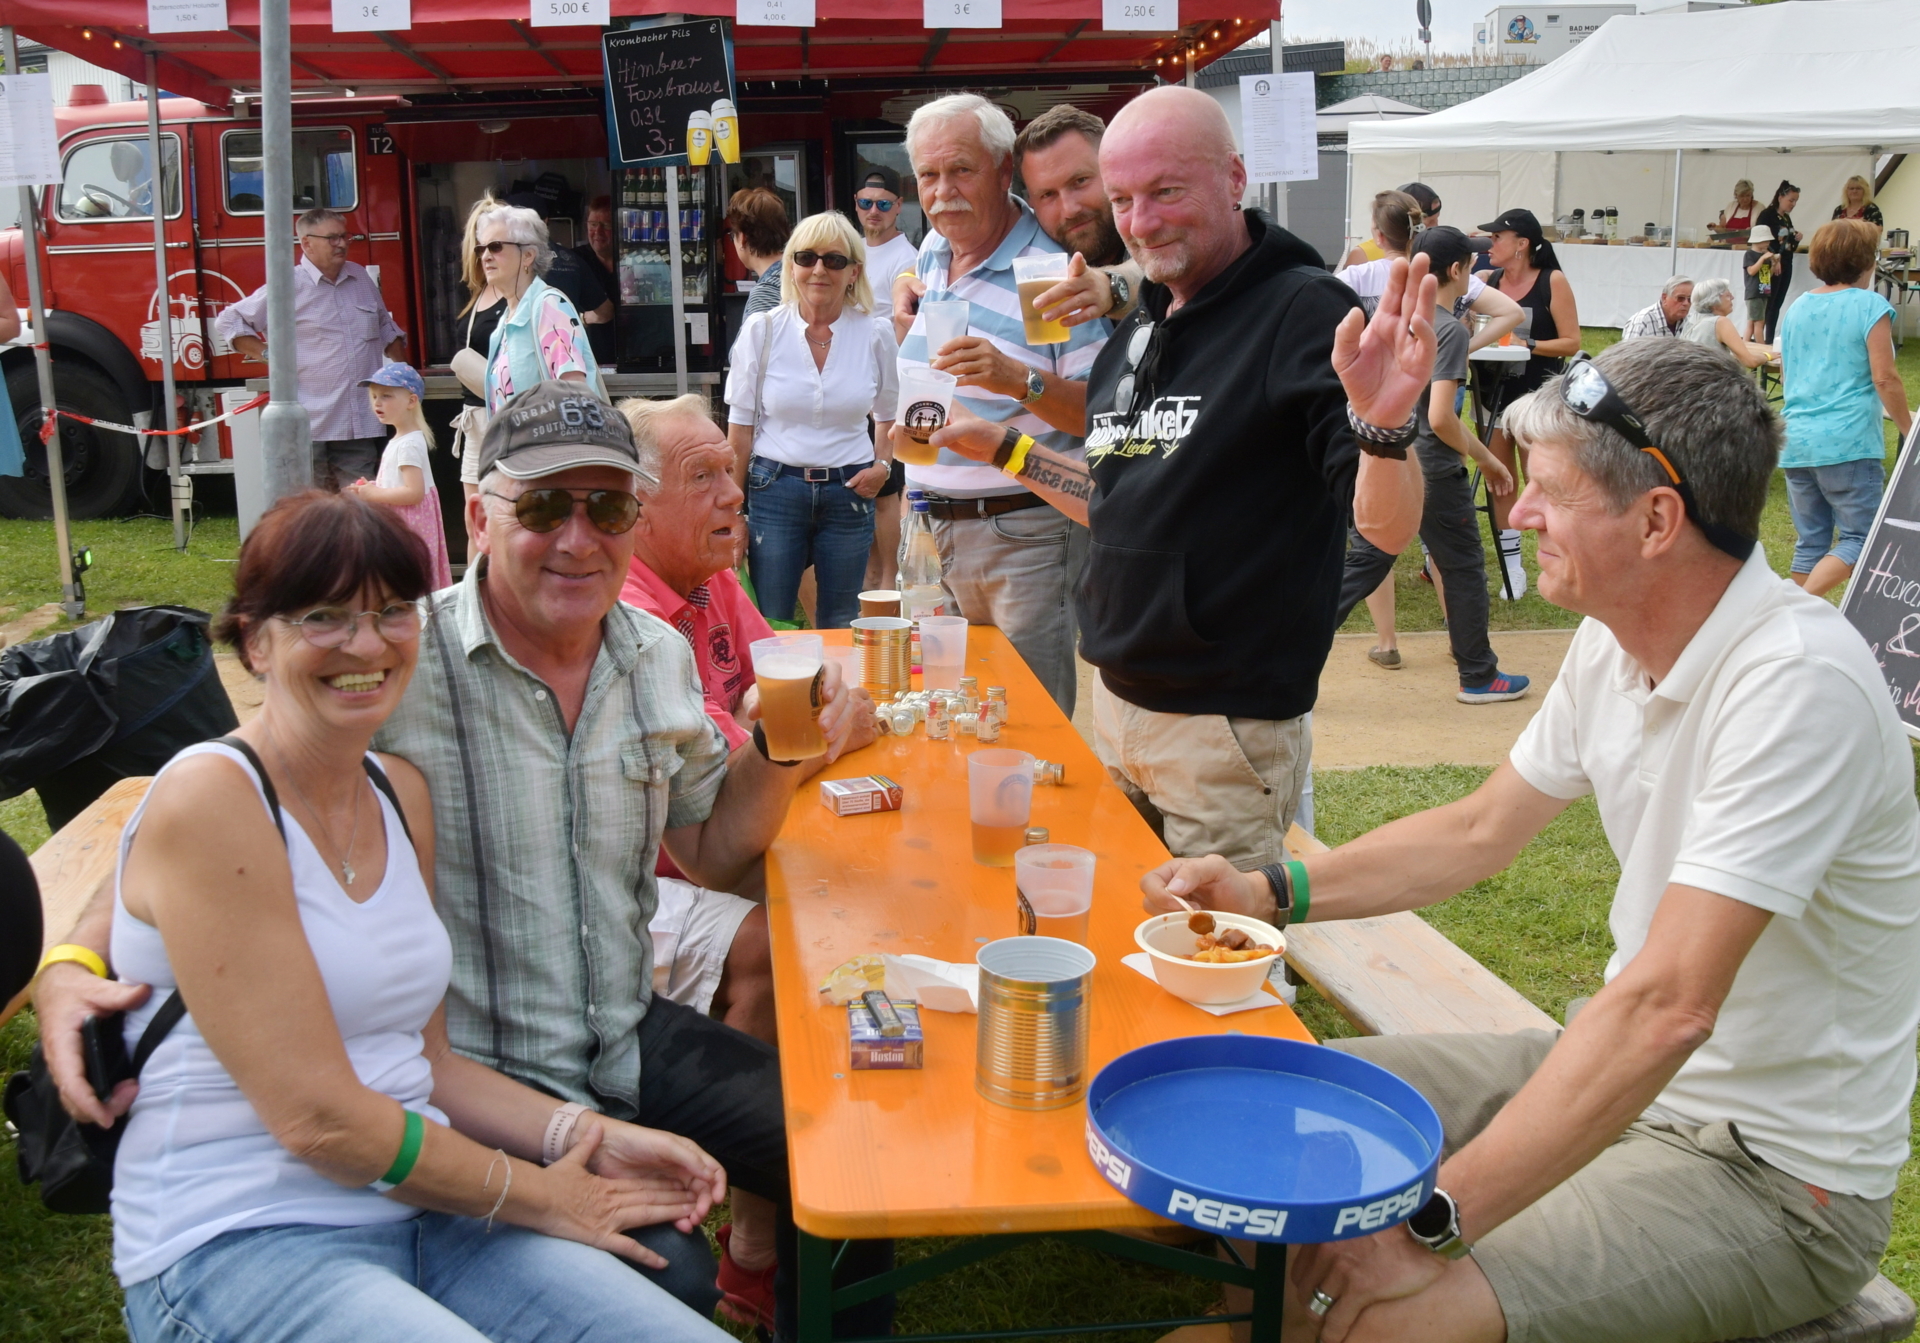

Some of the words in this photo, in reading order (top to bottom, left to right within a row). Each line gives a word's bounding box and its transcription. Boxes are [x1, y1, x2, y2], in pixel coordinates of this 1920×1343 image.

[176, 14, 192, 22] 1,50
[362, 6, 369, 18] 3
[371, 6, 379, 18] €
[550, 2, 579, 16] 5,00
[581, 2, 590, 14] €
[763, 13, 780, 21] 4,00
[954, 3, 961, 16] 3
[963, 3, 971, 15] €
[1124, 5, 1147, 18] 2,50
[1148, 6, 1156, 17] €
[609, 32, 668, 48] Krombacher
[671, 28, 691, 39] Pils
[709, 23, 717, 34] €
[617, 51, 702, 84] Himbeer
[623, 77, 724, 103] Fassbrause
[370, 136, 393, 154] T2
[0, 173, 37, 182] ECHERPFAND
[1254, 170, 1295, 178] BECHERPFAND
[511, 399, 556, 427] URBAN
[558, 399, 606, 428] 63
[532, 420, 566, 438] SOUTH
[870, 1051, 904, 1062] Boston
[1085, 1118, 1133, 1190] PEPSI
[1167, 1188, 1289, 1237] PEPSI
[1332, 1180, 1424, 1235] PEPSI
